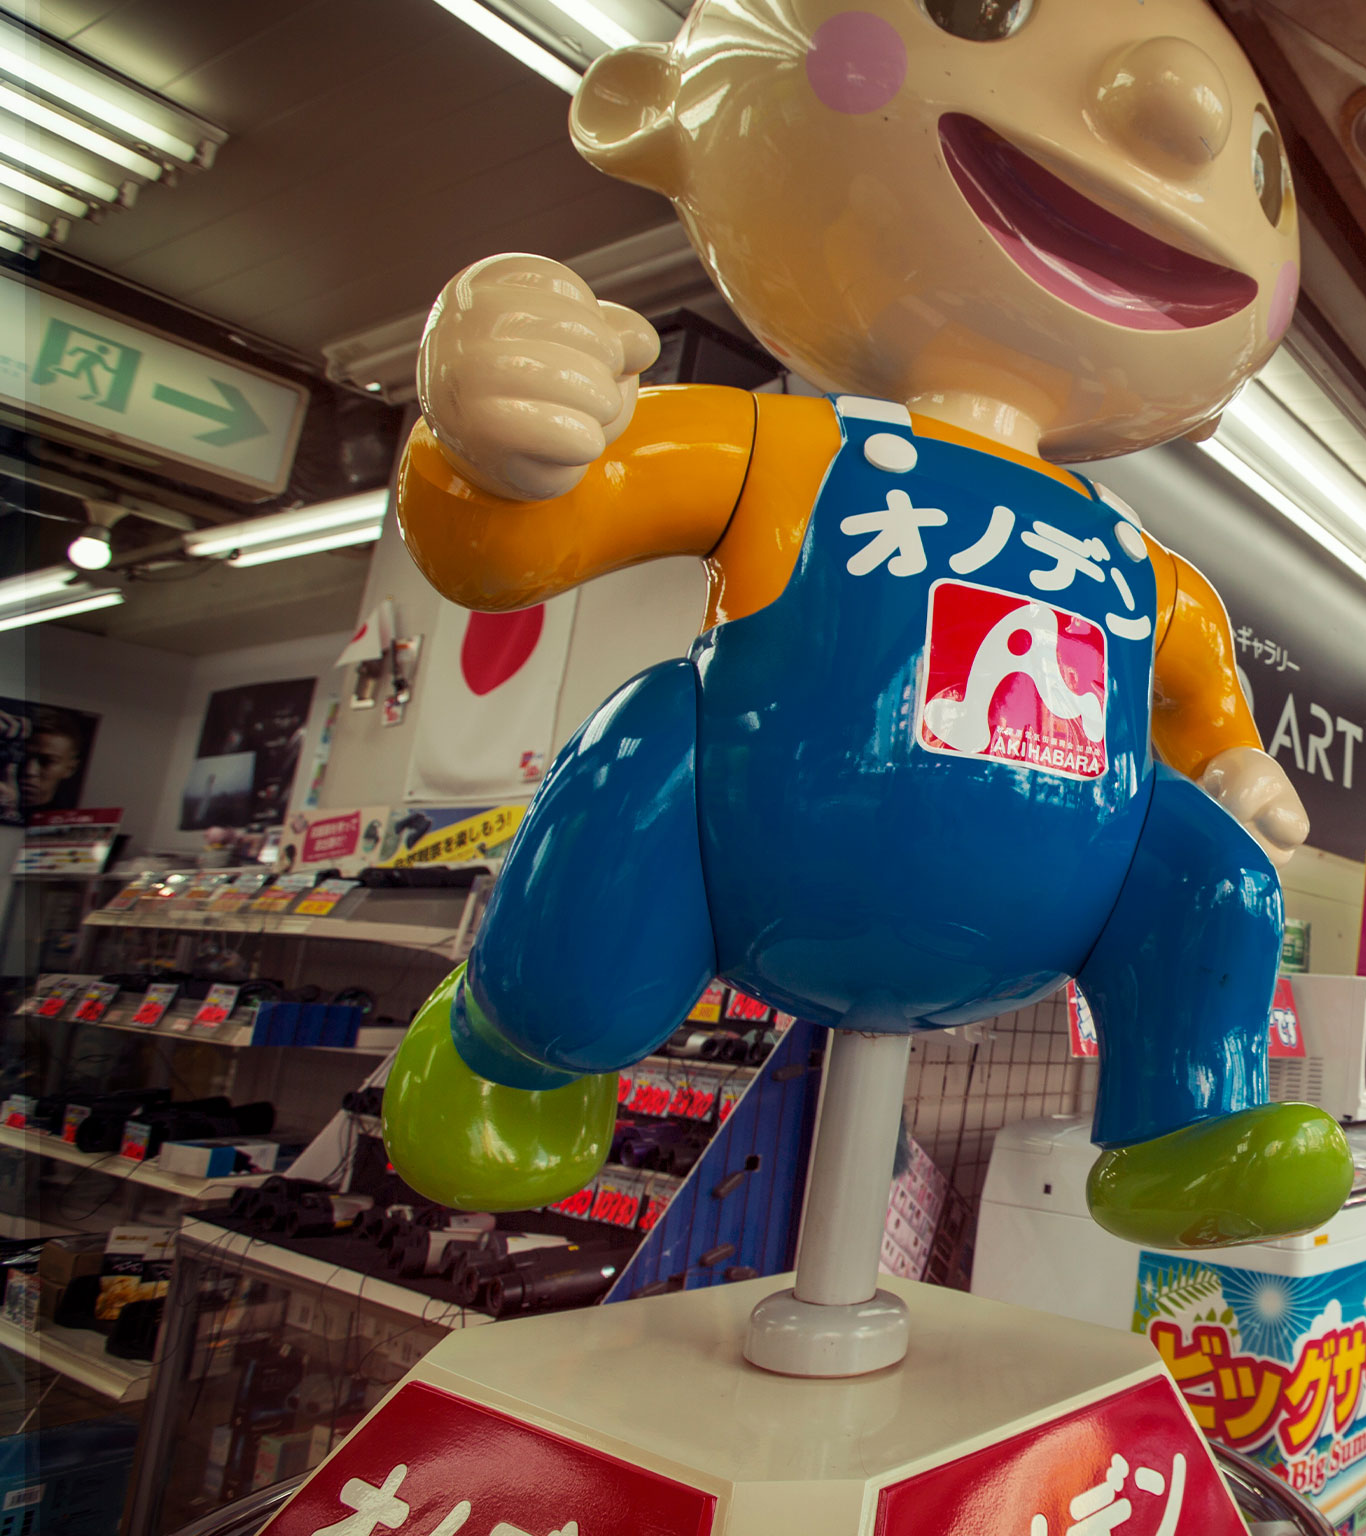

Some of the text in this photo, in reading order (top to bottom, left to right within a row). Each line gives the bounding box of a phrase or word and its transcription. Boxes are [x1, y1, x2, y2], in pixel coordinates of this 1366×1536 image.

[840, 489, 1151, 640] オノデン
[1233, 624, 1300, 672] ギャラリー
[992, 736, 1101, 775] AKIHABARA
[1268, 692, 1364, 790] ART
[1291, 1452, 1327, 1490] Big
